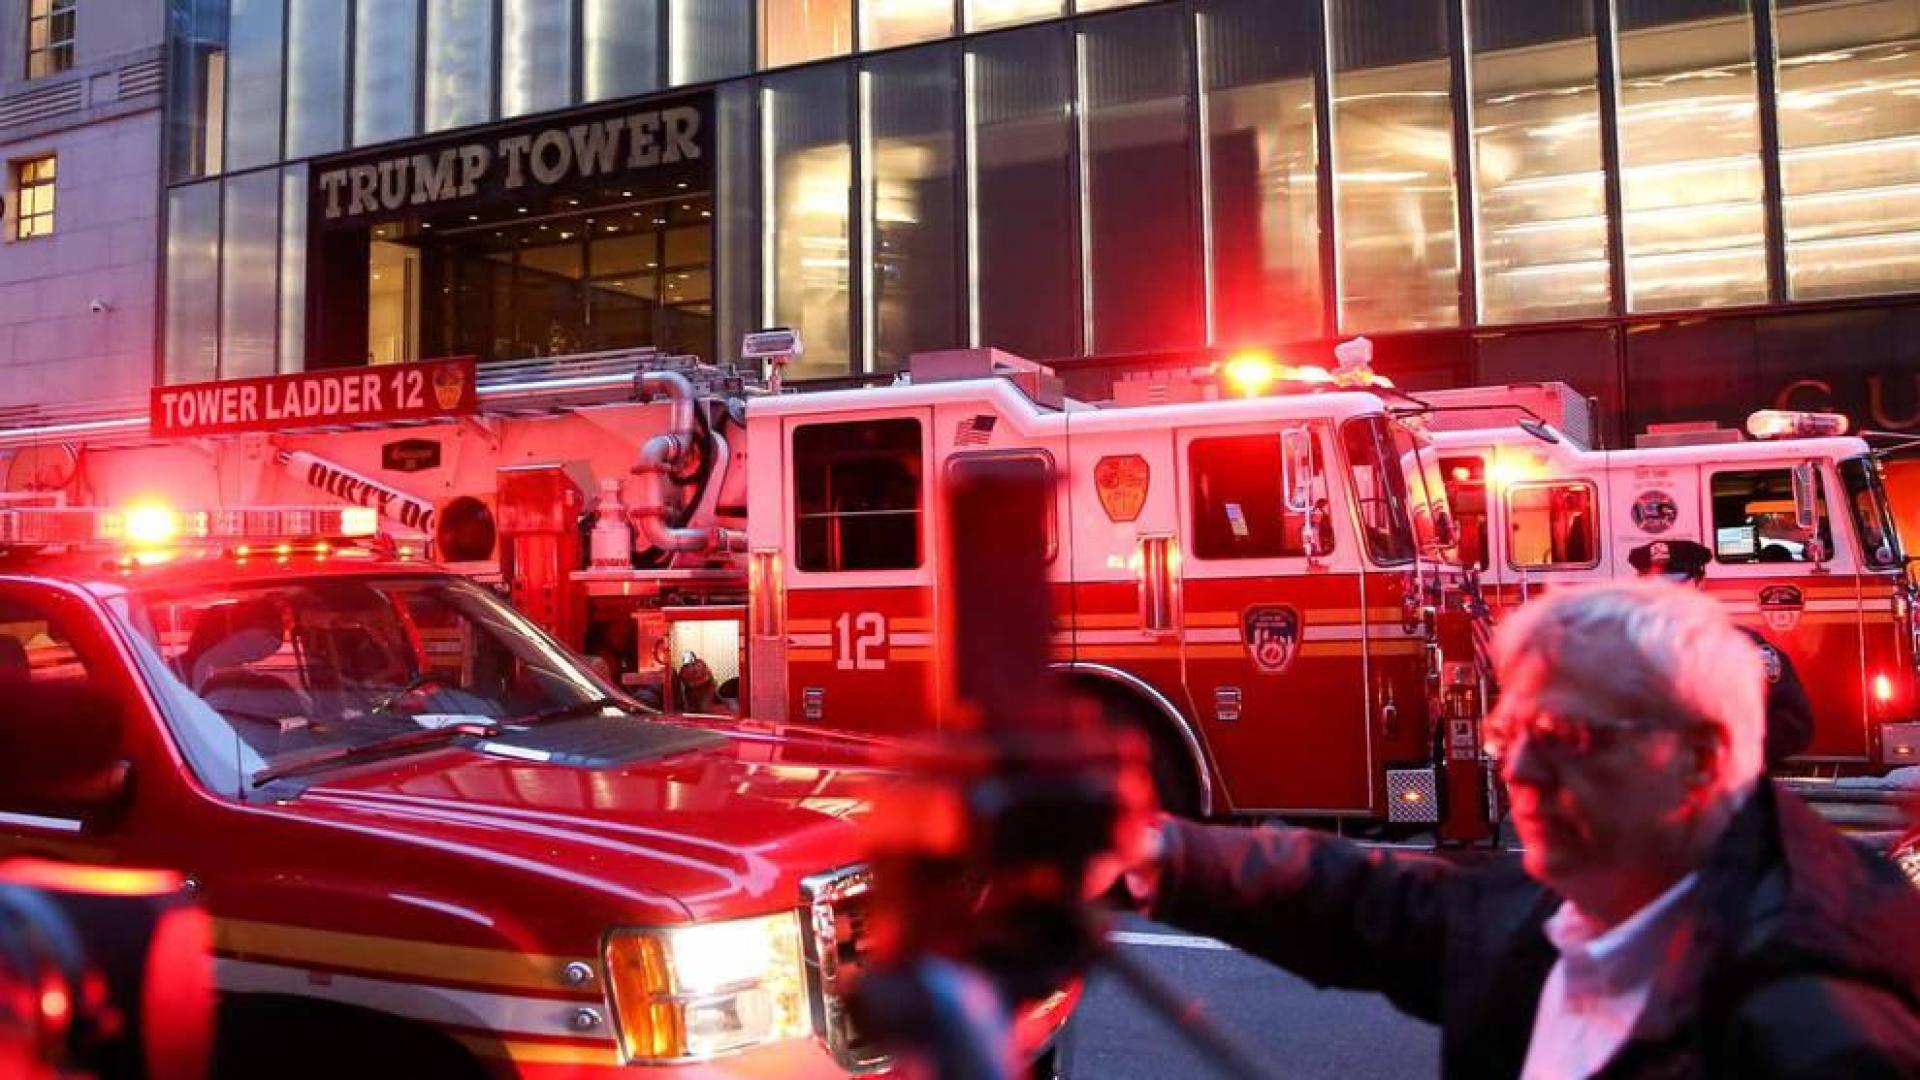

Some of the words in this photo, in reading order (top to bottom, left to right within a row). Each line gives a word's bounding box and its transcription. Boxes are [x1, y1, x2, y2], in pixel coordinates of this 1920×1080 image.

[320, 143, 491, 219] TRUMP
[500, 106, 701, 190] TOWER
[161, 385, 259, 428] TOWER
[265, 374, 383, 421] LADDER
[391, 369, 424, 410] 12
[307, 462, 399, 517] DIRTY
[835, 612, 885, 670] 12
